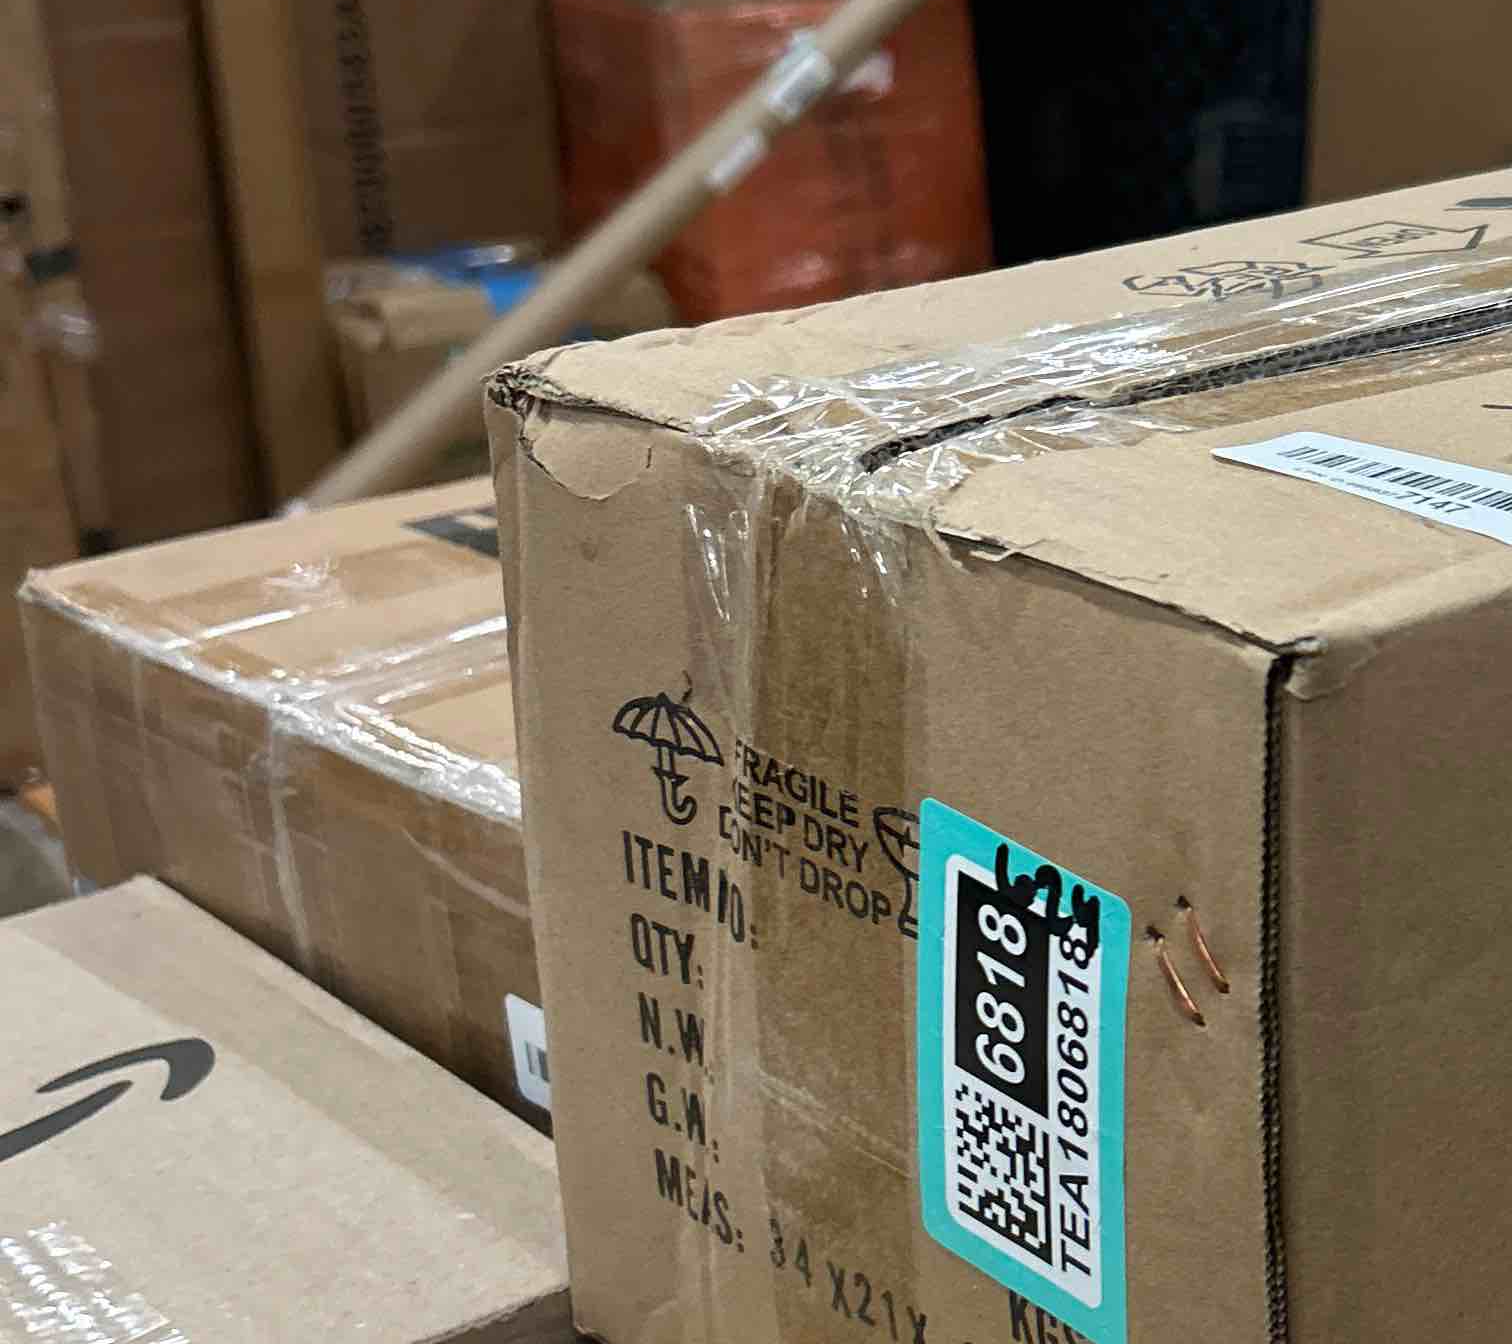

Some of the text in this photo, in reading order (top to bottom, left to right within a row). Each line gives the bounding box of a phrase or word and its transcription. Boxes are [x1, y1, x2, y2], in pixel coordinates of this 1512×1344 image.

[733, 778, 869, 872] EEP DRY
[622, 830, 710, 913] ITEM
[800, 856, 892, 925] DROP
[631, 913, 704, 990] QTY:
[975, 904, 1027, 1084] 6818
[1057, 937, 1091, 1276] TEA1806818
